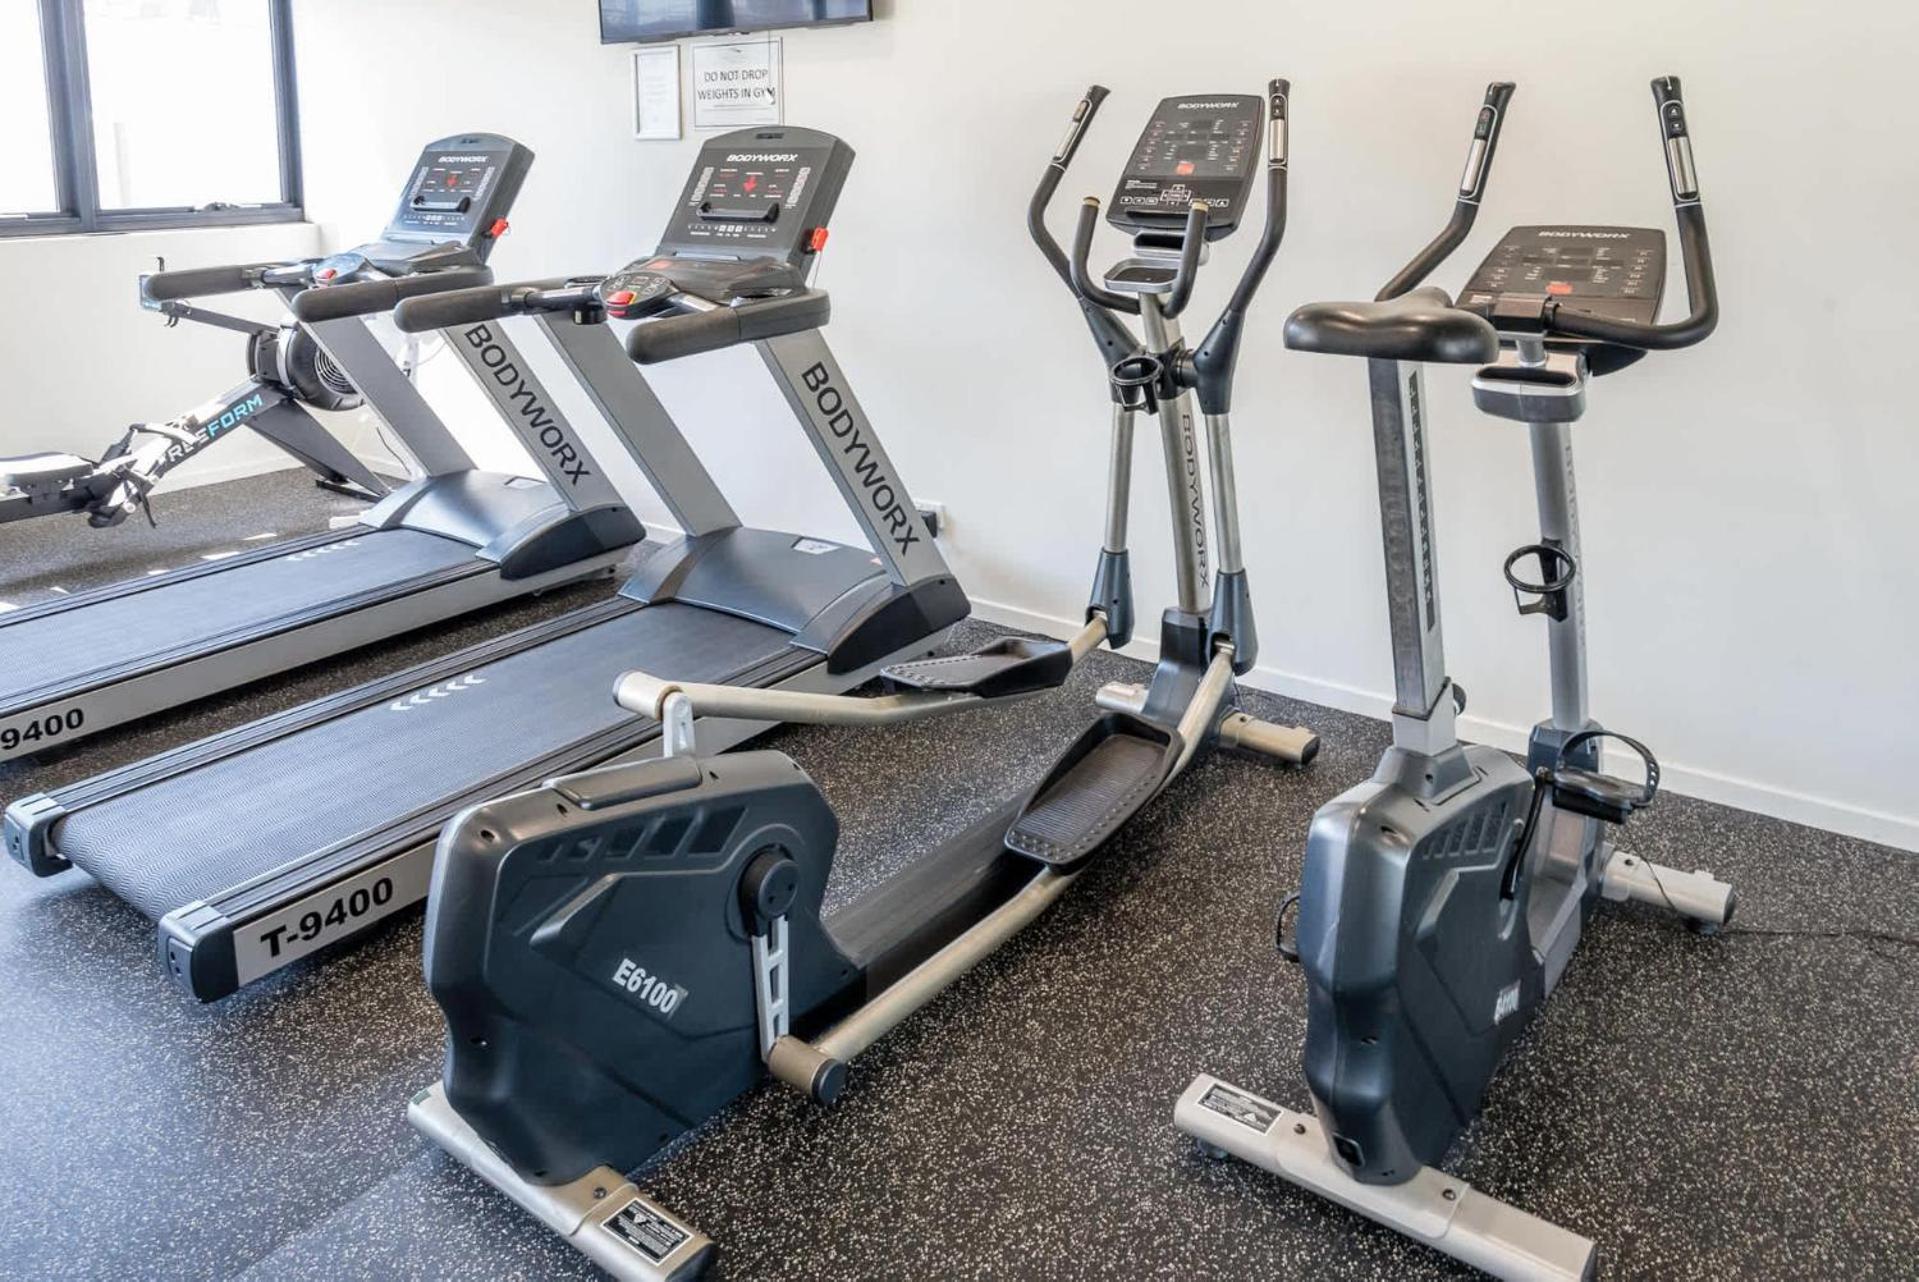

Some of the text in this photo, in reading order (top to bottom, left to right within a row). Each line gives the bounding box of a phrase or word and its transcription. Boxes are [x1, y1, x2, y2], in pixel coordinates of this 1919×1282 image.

[697, 87, 739, 100] WEIGHTS
[741, 88, 751, 98] IN
[703, 68, 769, 82] DO NOT DROP
[726, 153, 798, 162] BODYWORX
[1538, 230, 1632, 240] BODYWORX
[464, 323, 591, 486] BODYWORX
[801, 361, 920, 556] BODYWORX
[0, 707, 84, 751] 9400
[260, 877, 394, 958] T-9400
[612, 958, 679, 1014] E6100
